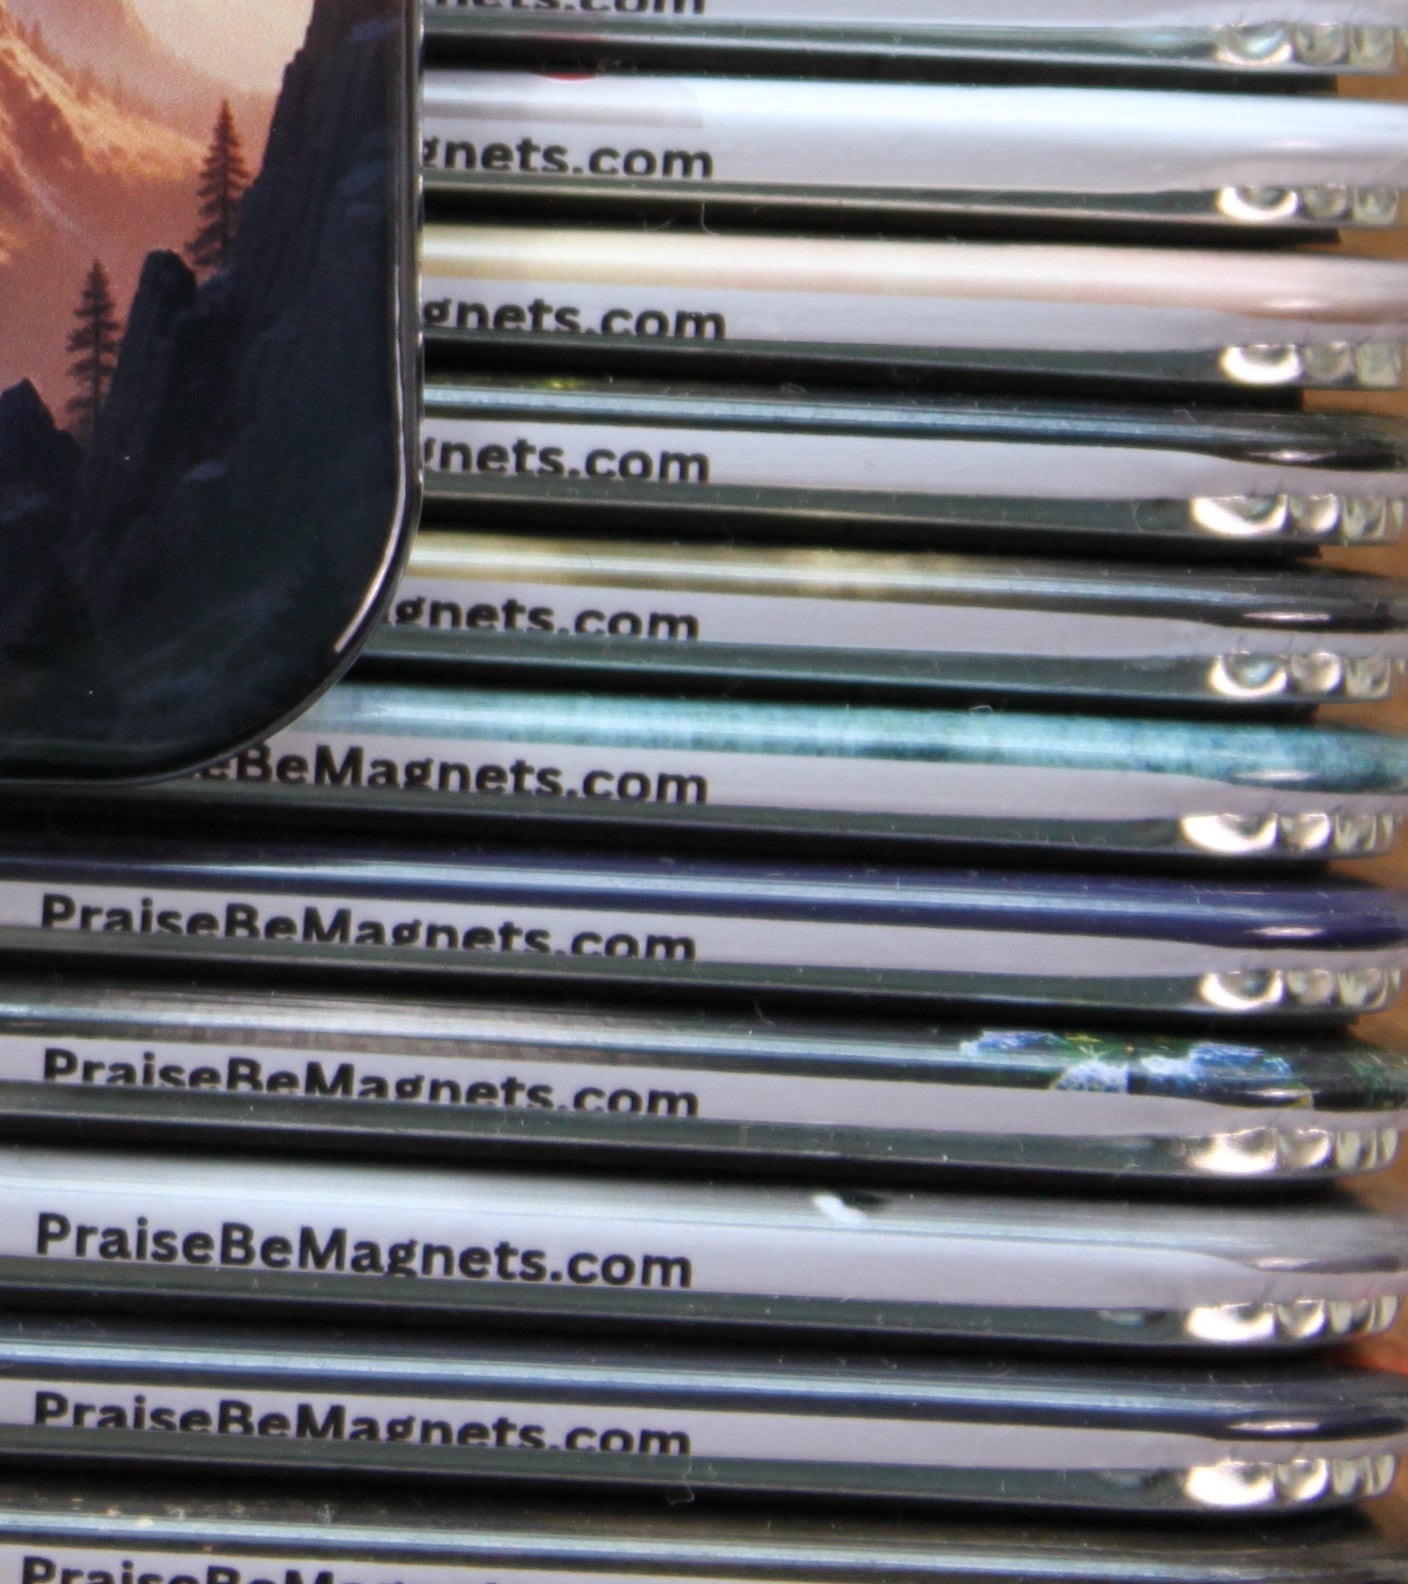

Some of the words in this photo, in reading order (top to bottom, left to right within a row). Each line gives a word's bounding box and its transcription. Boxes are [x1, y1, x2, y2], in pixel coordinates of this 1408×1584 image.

[40, 893, 698, 963] PraiseBeMagnets.com
[42, 1047, 700, 1118] PraiseBeMagnets.com
[36, 1211, 694, 1290] PraiseBeMagnets.com
[33, 1391, 693, 1457] PraiseBeMagnets.com
